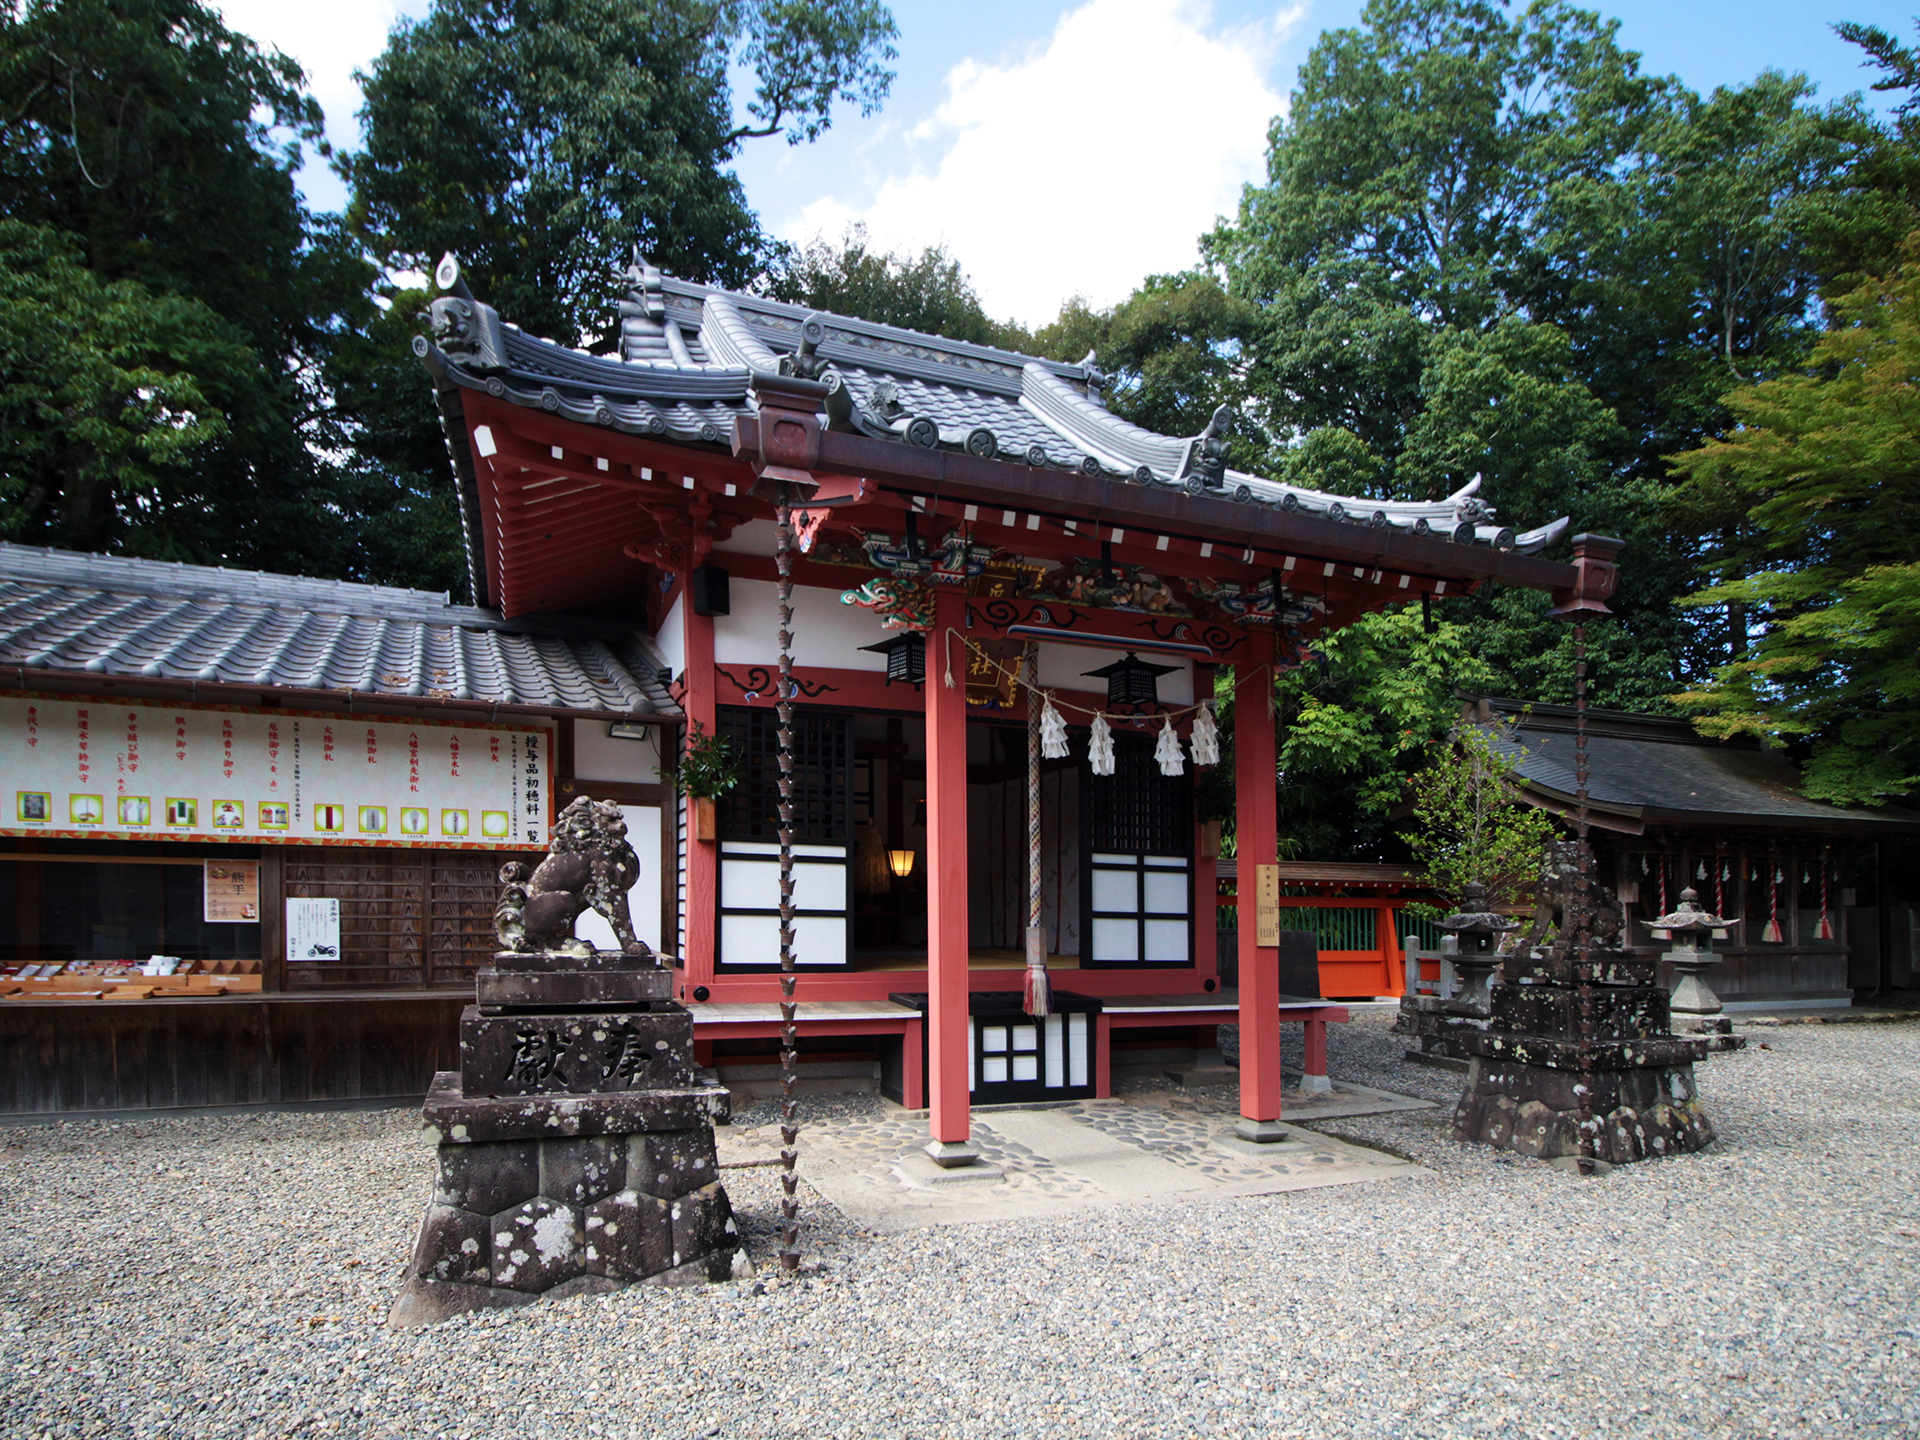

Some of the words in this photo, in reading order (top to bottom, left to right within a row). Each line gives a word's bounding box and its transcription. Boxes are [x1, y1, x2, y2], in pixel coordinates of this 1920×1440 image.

[323, 726, 334, 762] 火除御札
[367, 728, 377, 764] 厄除御札
[449, 735, 460, 777] 八幡宮木札
[491, 736, 500, 763] 御神矢
[524, 735, 540, 843] 授与品初穂料一覧
[231, 871, 246, 895] 熊手
